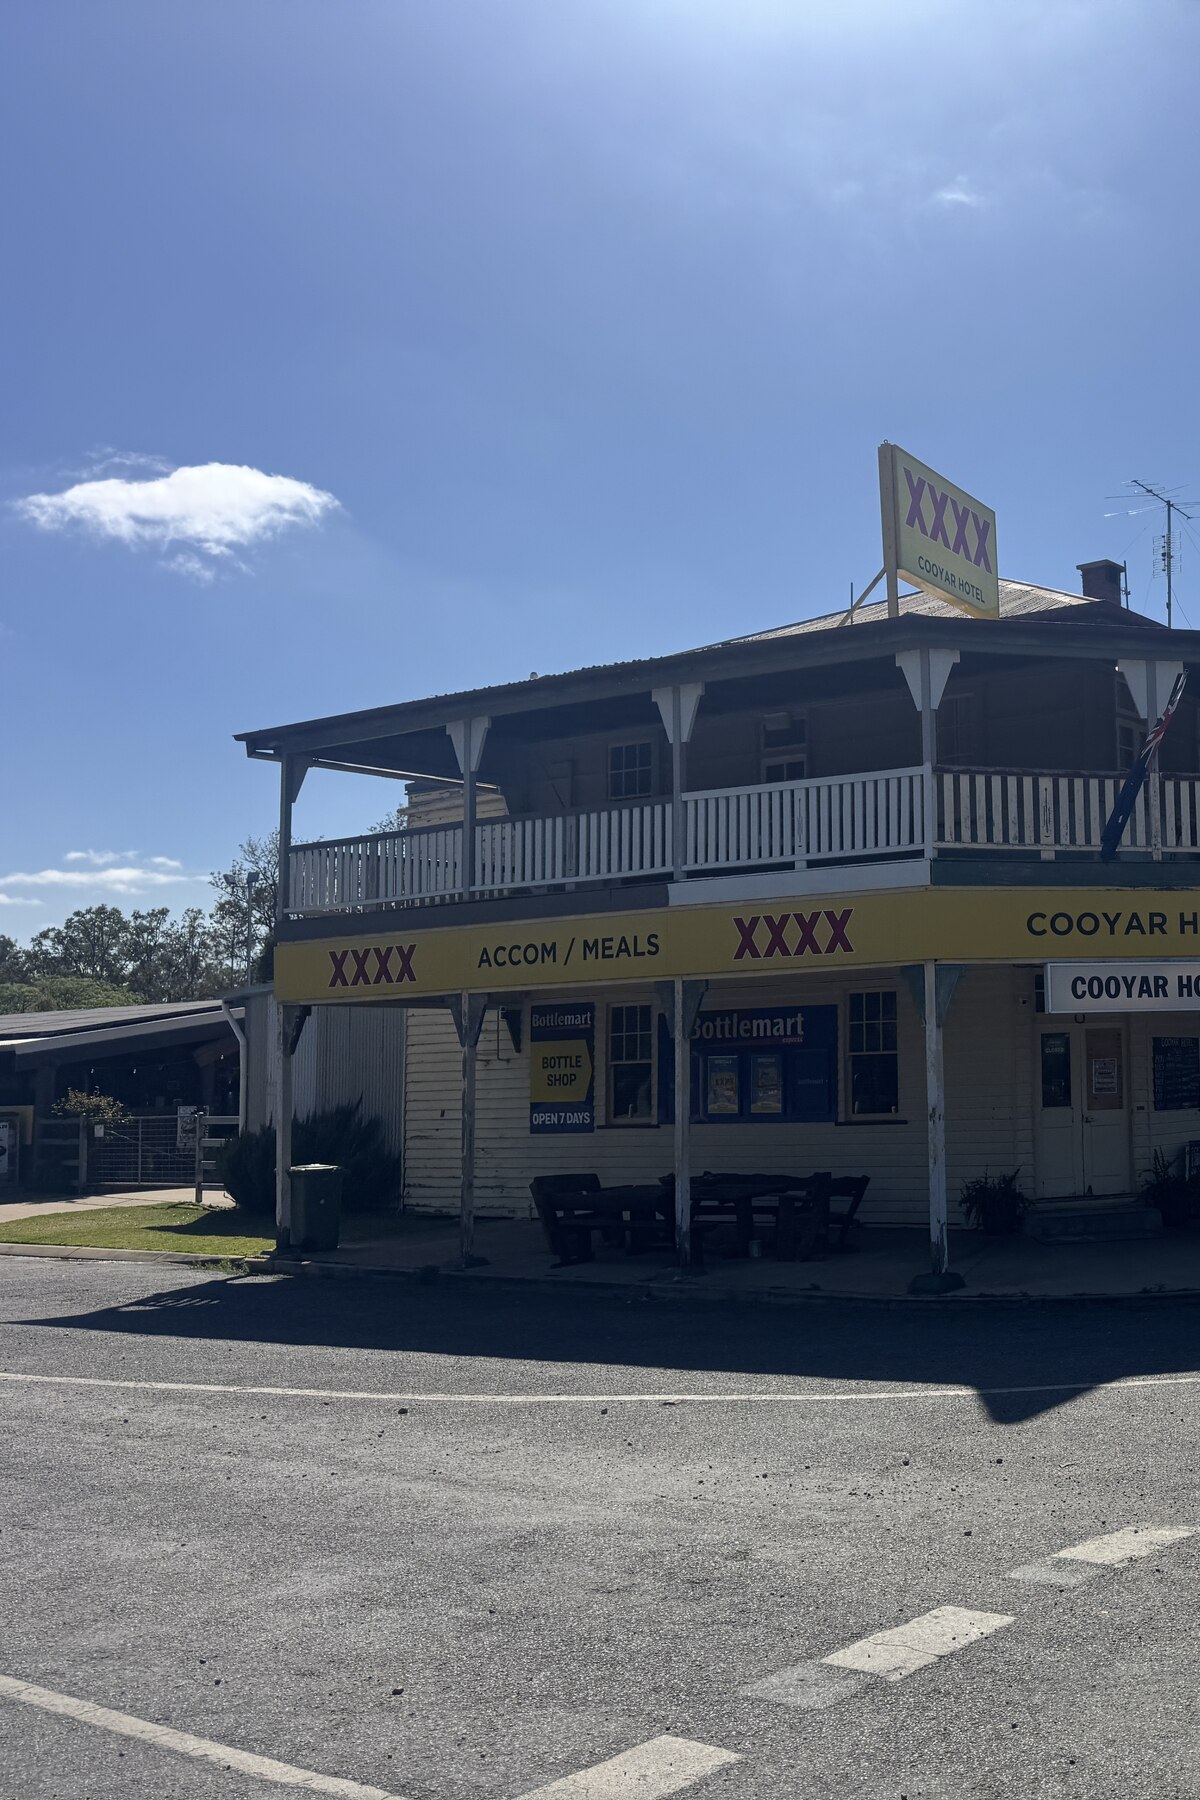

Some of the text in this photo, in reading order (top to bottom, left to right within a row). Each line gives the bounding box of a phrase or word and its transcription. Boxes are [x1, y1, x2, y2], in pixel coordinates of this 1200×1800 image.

[903, 467, 992, 574] XXXX
[918, 556, 985, 603] COOYAR HOTEL
[733, 908, 854, 960] XXXX
[1026, 912, 1168, 936] COOYAR
[477, 942, 557, 968] ACCOM
[583, 934, 659, 961] MEALS
[328, 944, 417, 987] XXXX
[1071, 975, 1169, 1000] COOYAR
[532, 1011, 592, 1027] Bottlemart
[542, 1055, 582, 1069] BOTTLE
[546, 1073, 577, 1087] SHOP
[532, 1111, 591, 1125] OPEN 7 DAYS
